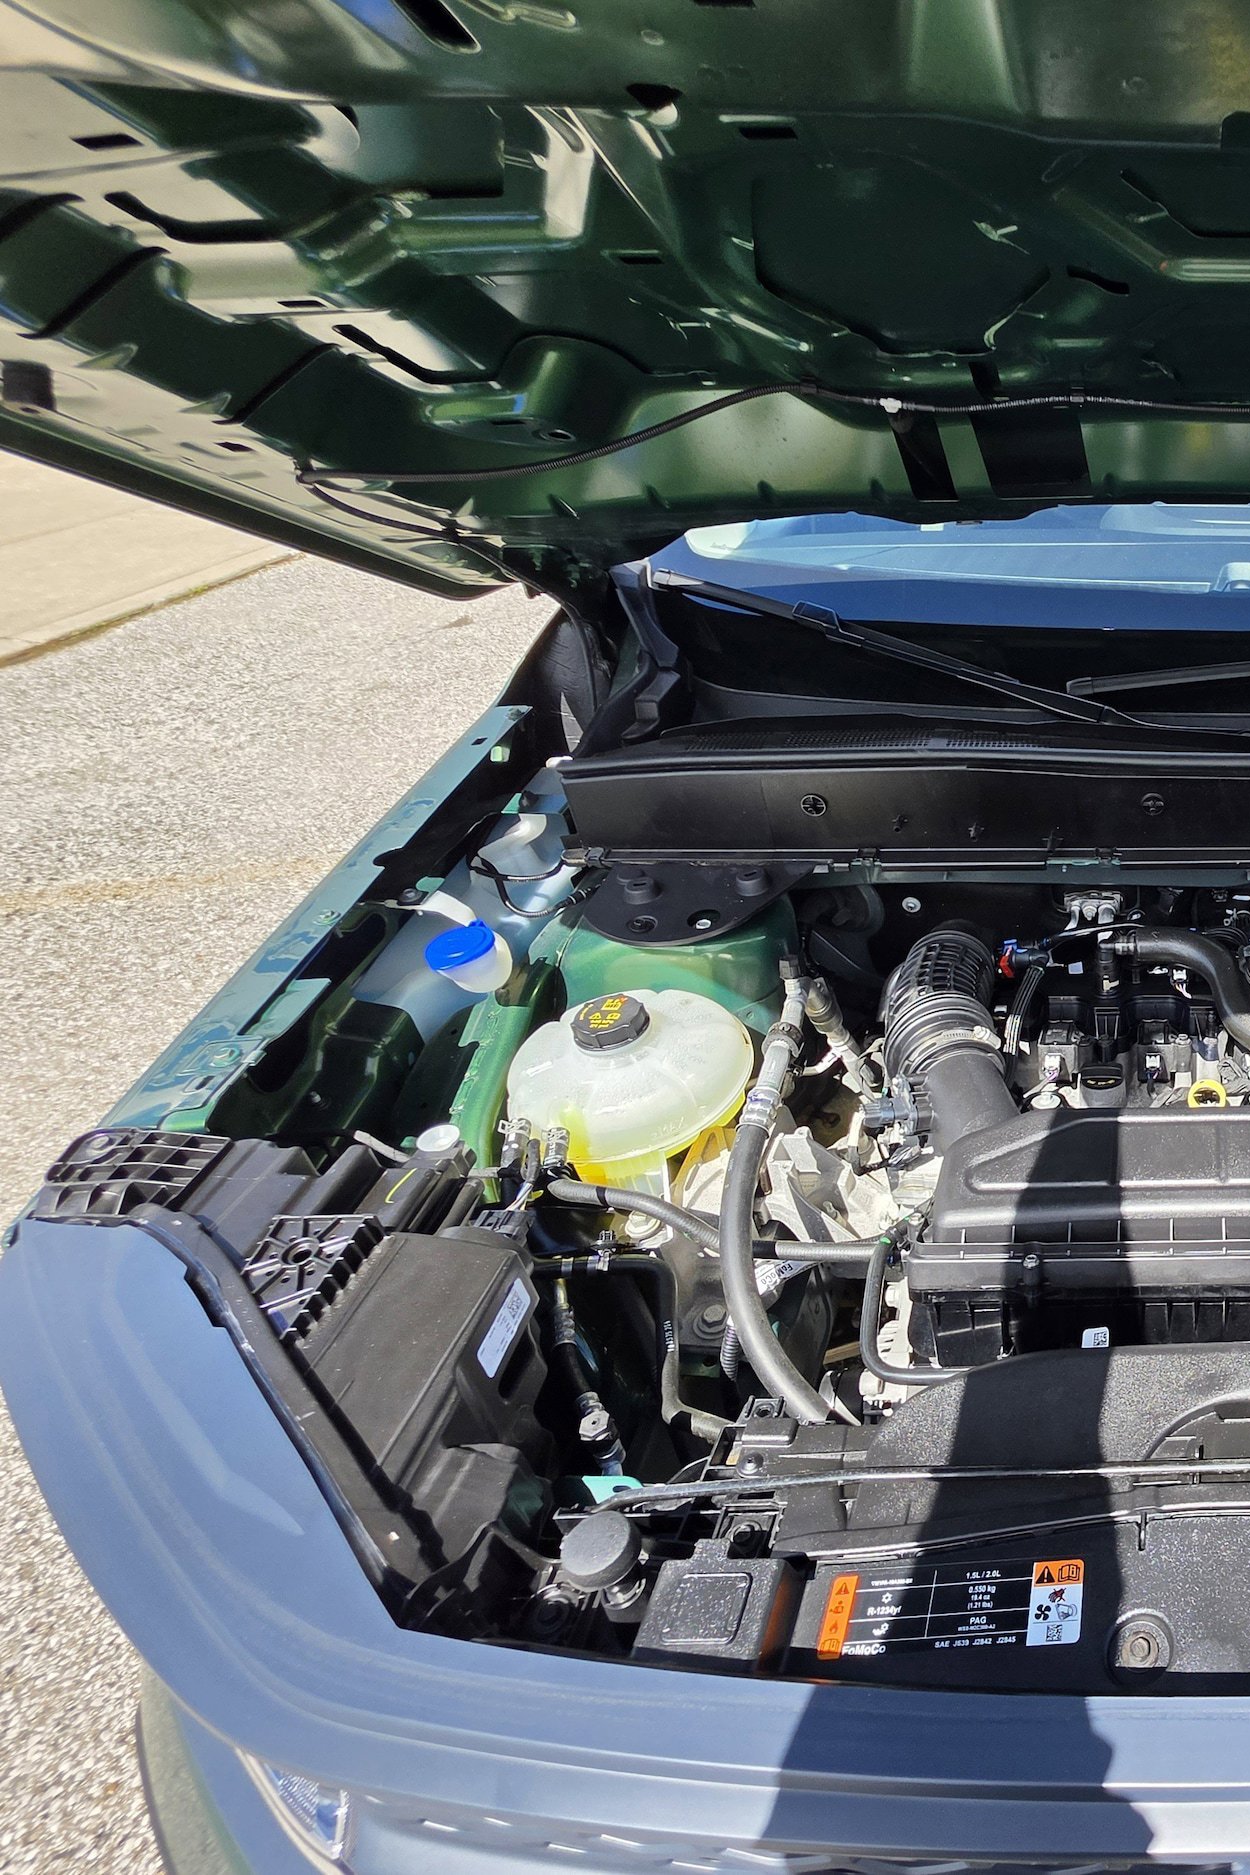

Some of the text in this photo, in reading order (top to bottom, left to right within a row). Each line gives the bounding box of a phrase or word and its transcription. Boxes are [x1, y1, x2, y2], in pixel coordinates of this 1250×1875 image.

[966, 1571, 981, 1580] 1.5L
[867, 1605, 903, 1617] R-1234yf
[969, 1616, 988, 1625] PAG
[841, 1644, 887, 1656] FoMoCo
